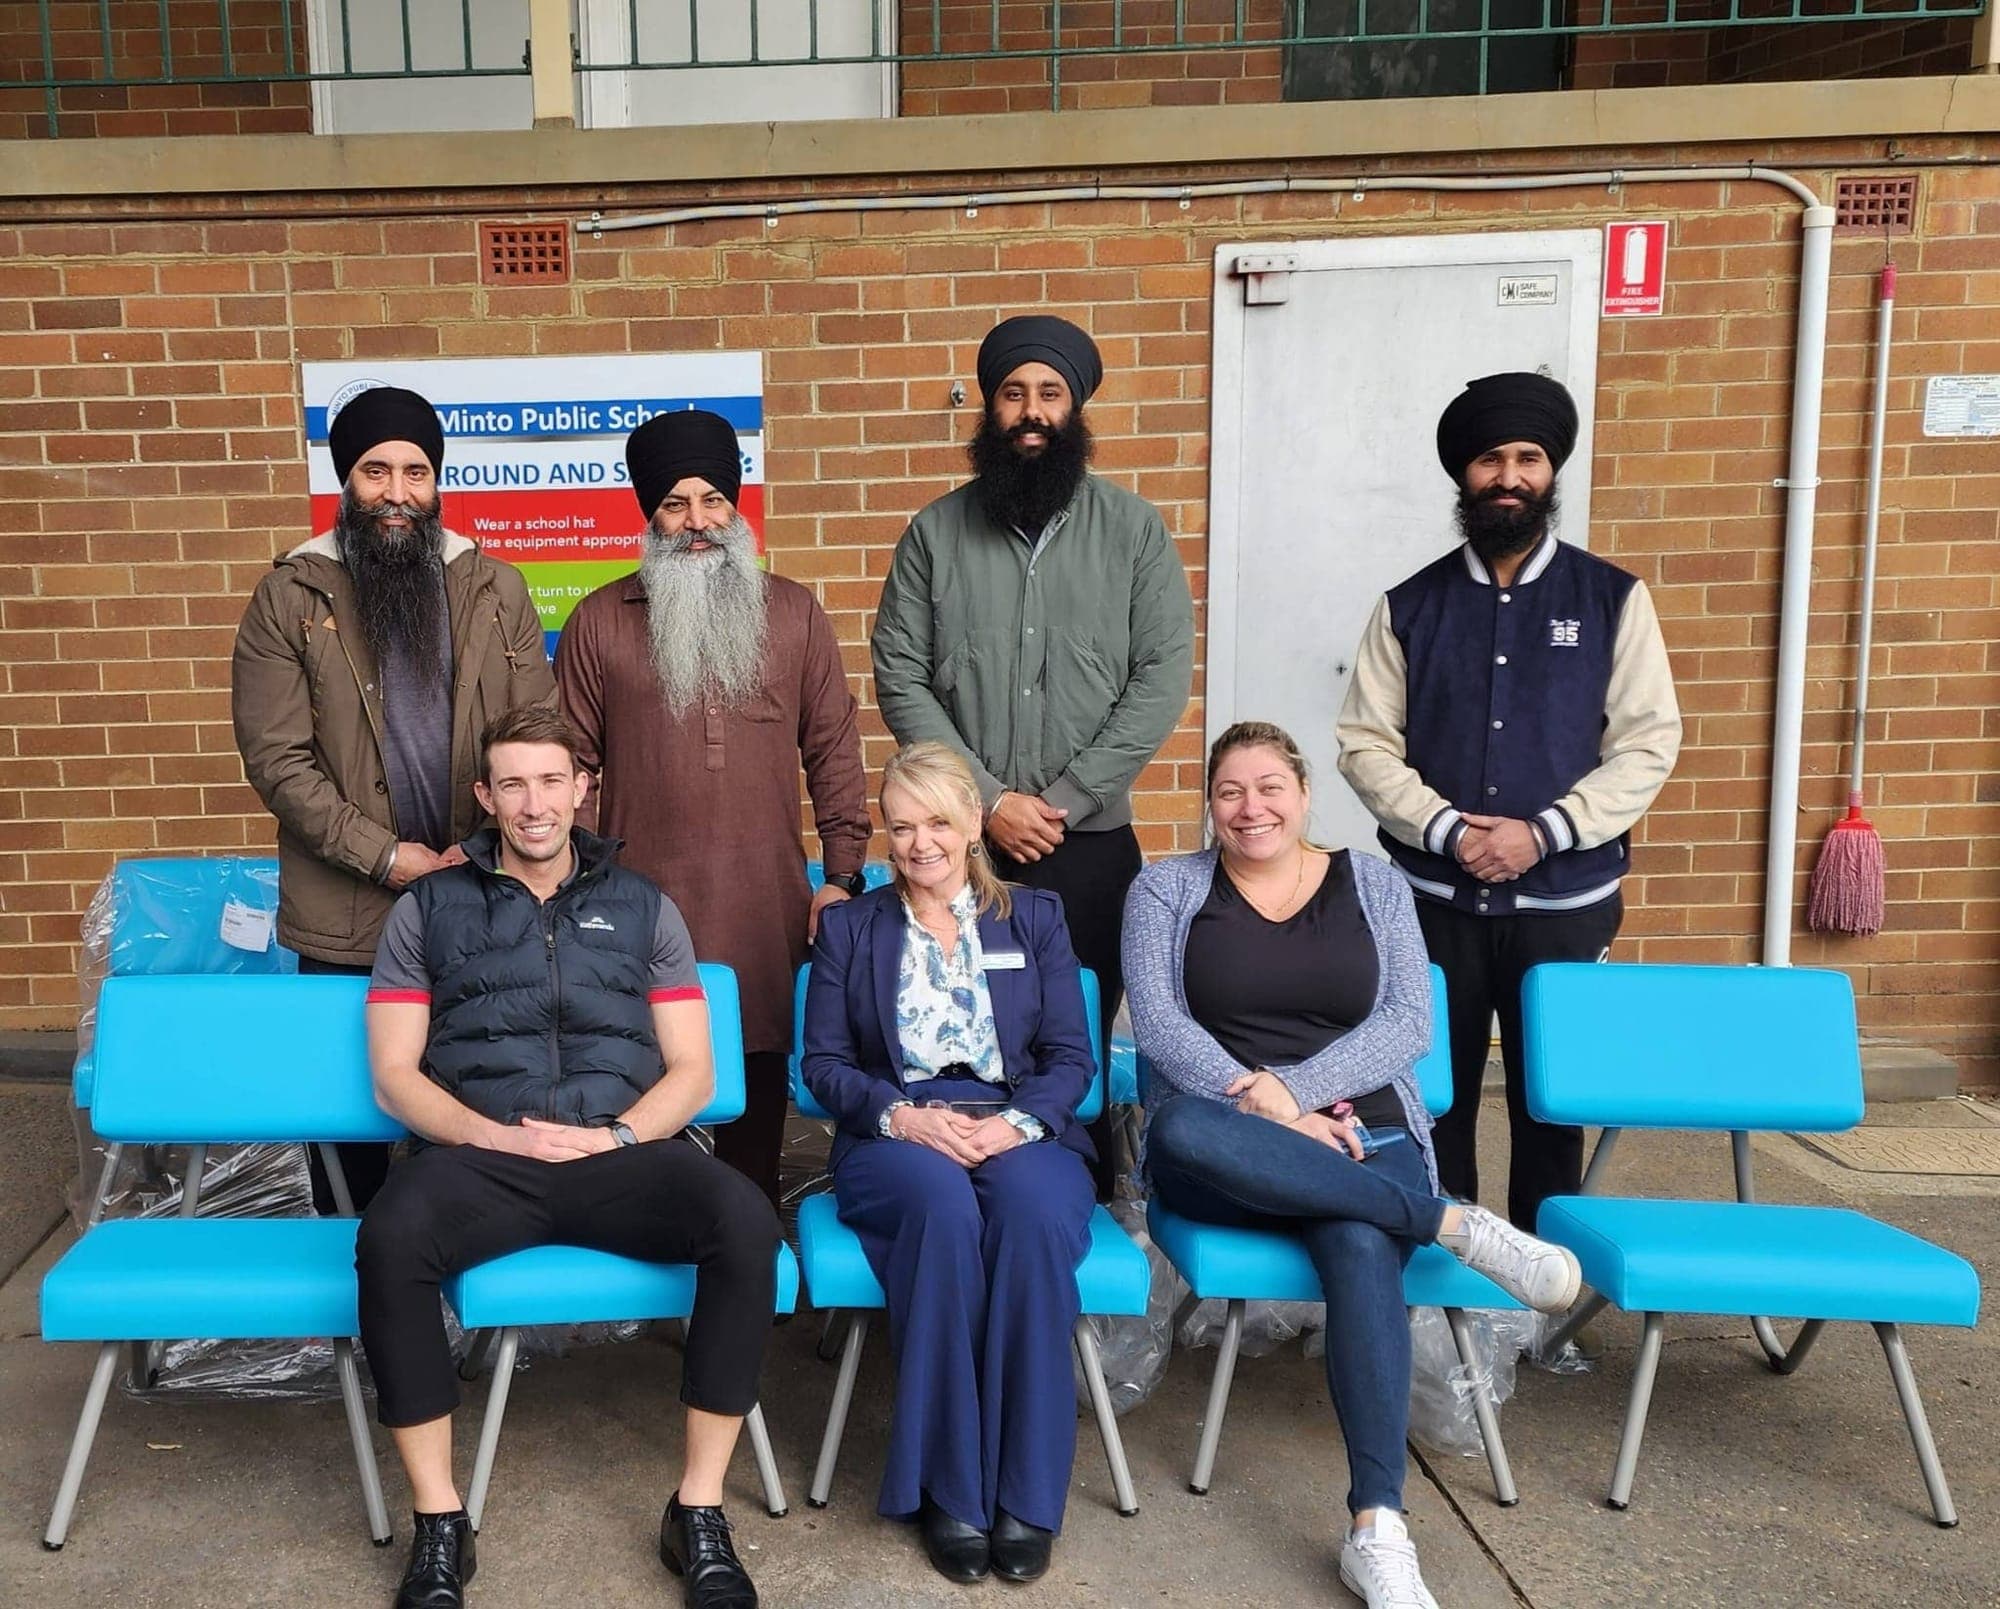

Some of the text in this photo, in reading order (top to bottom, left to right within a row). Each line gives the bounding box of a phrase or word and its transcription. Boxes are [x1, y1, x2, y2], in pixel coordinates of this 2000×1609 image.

[1520, 282, 1537, 290] SAFE
[1621, 286, 1643, 296] FIRE
[1520, 290, 1553, 299] COMPANY
[436, 403, 694, 432] Minto Public Sch
[438, 464, 540, 486] ROUND
[549, 462, 605, 484] AND
[474, 515, 596, 531] Wear a school hat
[504, 534, 579, 552] equipment
[582, 532, 644, 550] appropri
[537, 587, 564, 597] turn
[567, 586, 582, 596] to
[1552, 626, 1579, 642] 95
